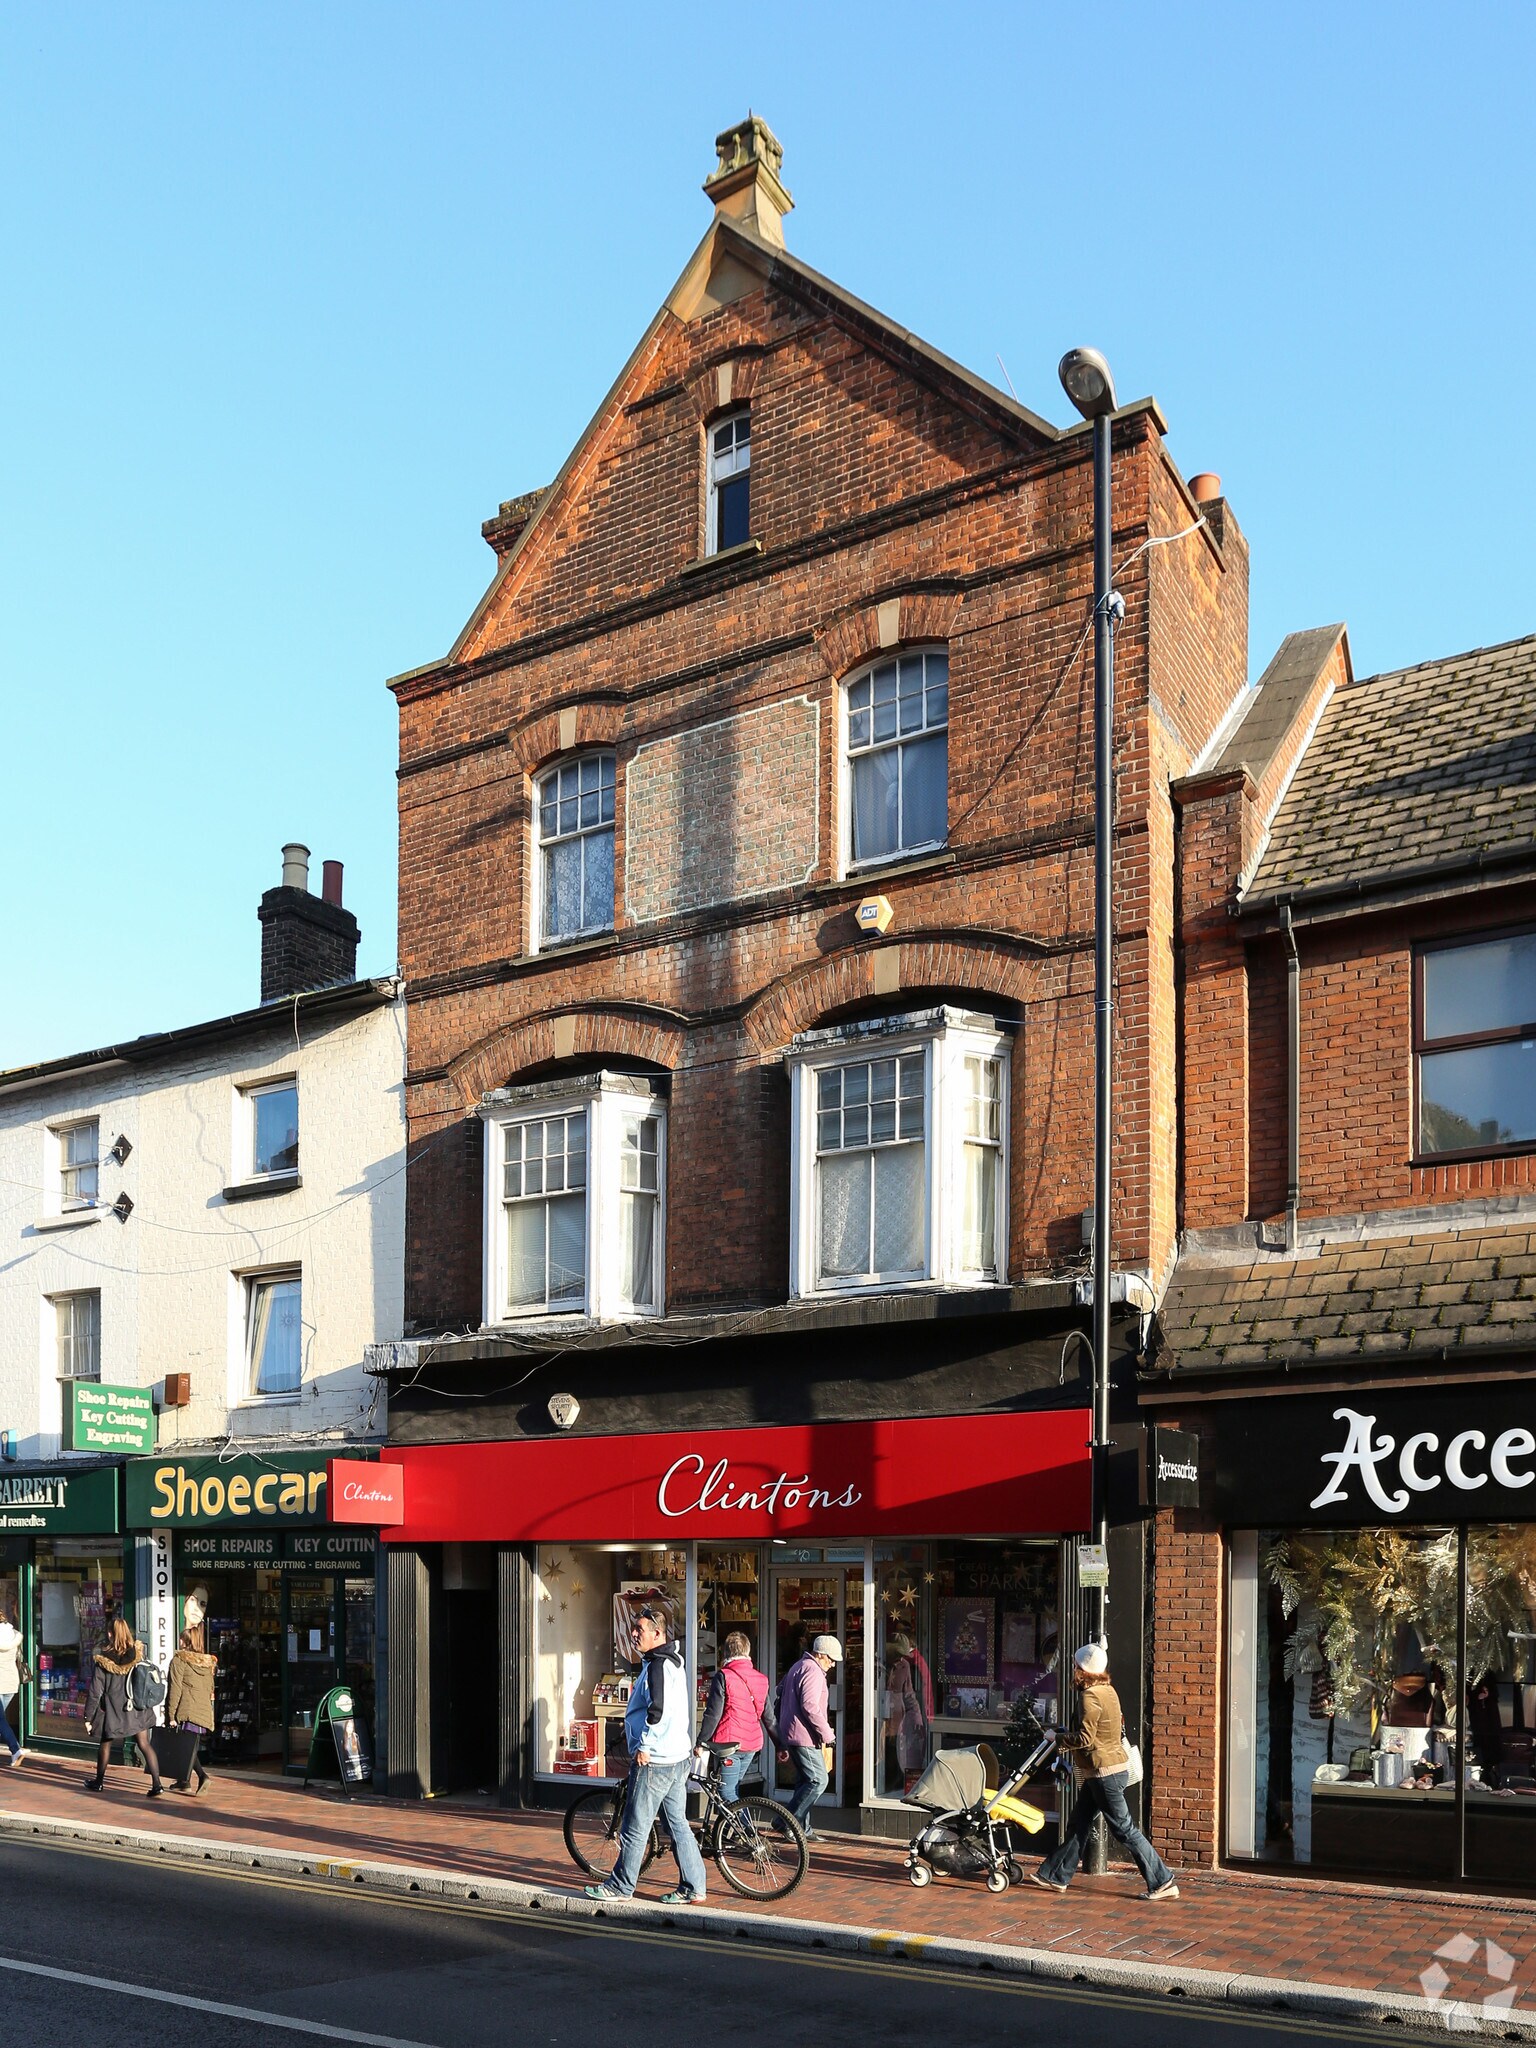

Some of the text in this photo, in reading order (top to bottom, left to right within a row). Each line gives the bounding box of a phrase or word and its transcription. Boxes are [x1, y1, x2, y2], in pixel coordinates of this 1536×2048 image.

[861, 907, 878, 918] ADT
[77, 1389, 150, 1410] Shoe Repairs
[81, 1408, 148, 1430] Key Cutting
[86, 1428, 143, 1447] Engraving
[1158, 1454, 1198, 1482] Accessorize
[1310, 1408, 1536, 1513] Acce
[150, 1466, 328, 1518] Shoecar
[343, 1482, 394, 1502] Clintons
[657, 1453, 863, 1517] Clintons
[8, 1513, 47, 1528] remedies
[184, 1538, 274, 1554] SHOE REPAIRS
[294, 1538, 321, 1553] KEY
[156, 1535, 169, 1603] SHOE
[192, 1560, 212, 1569] SHOE
[214, 1560, 246, 1569] REPAIRS
[253, 1560, 270, 1569] KEY
[272, 1560, 306, 1570] CUTTING
[314, 1560, 361, 1570] ENGRAVING
